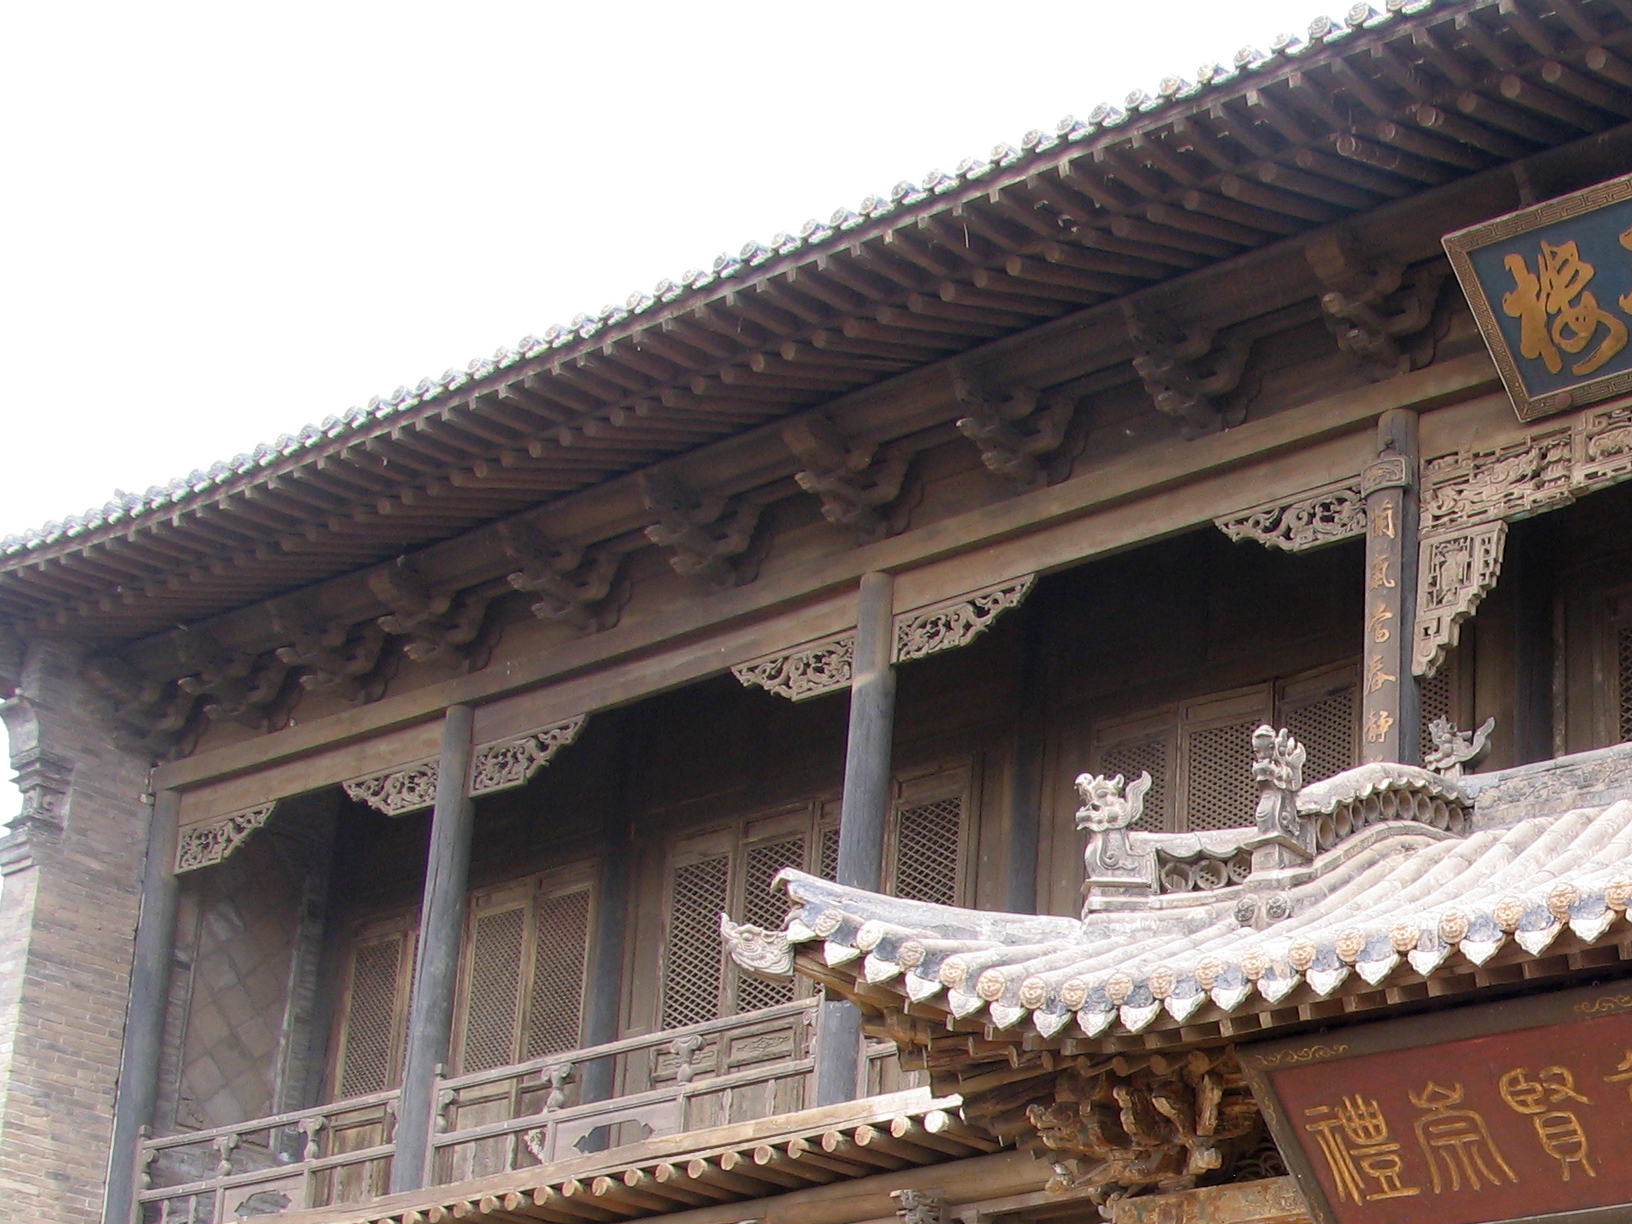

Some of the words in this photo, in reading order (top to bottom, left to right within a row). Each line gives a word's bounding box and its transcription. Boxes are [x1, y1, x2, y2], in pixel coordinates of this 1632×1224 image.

[1365, 500, 1397, 763] 蘭氣當春靜
